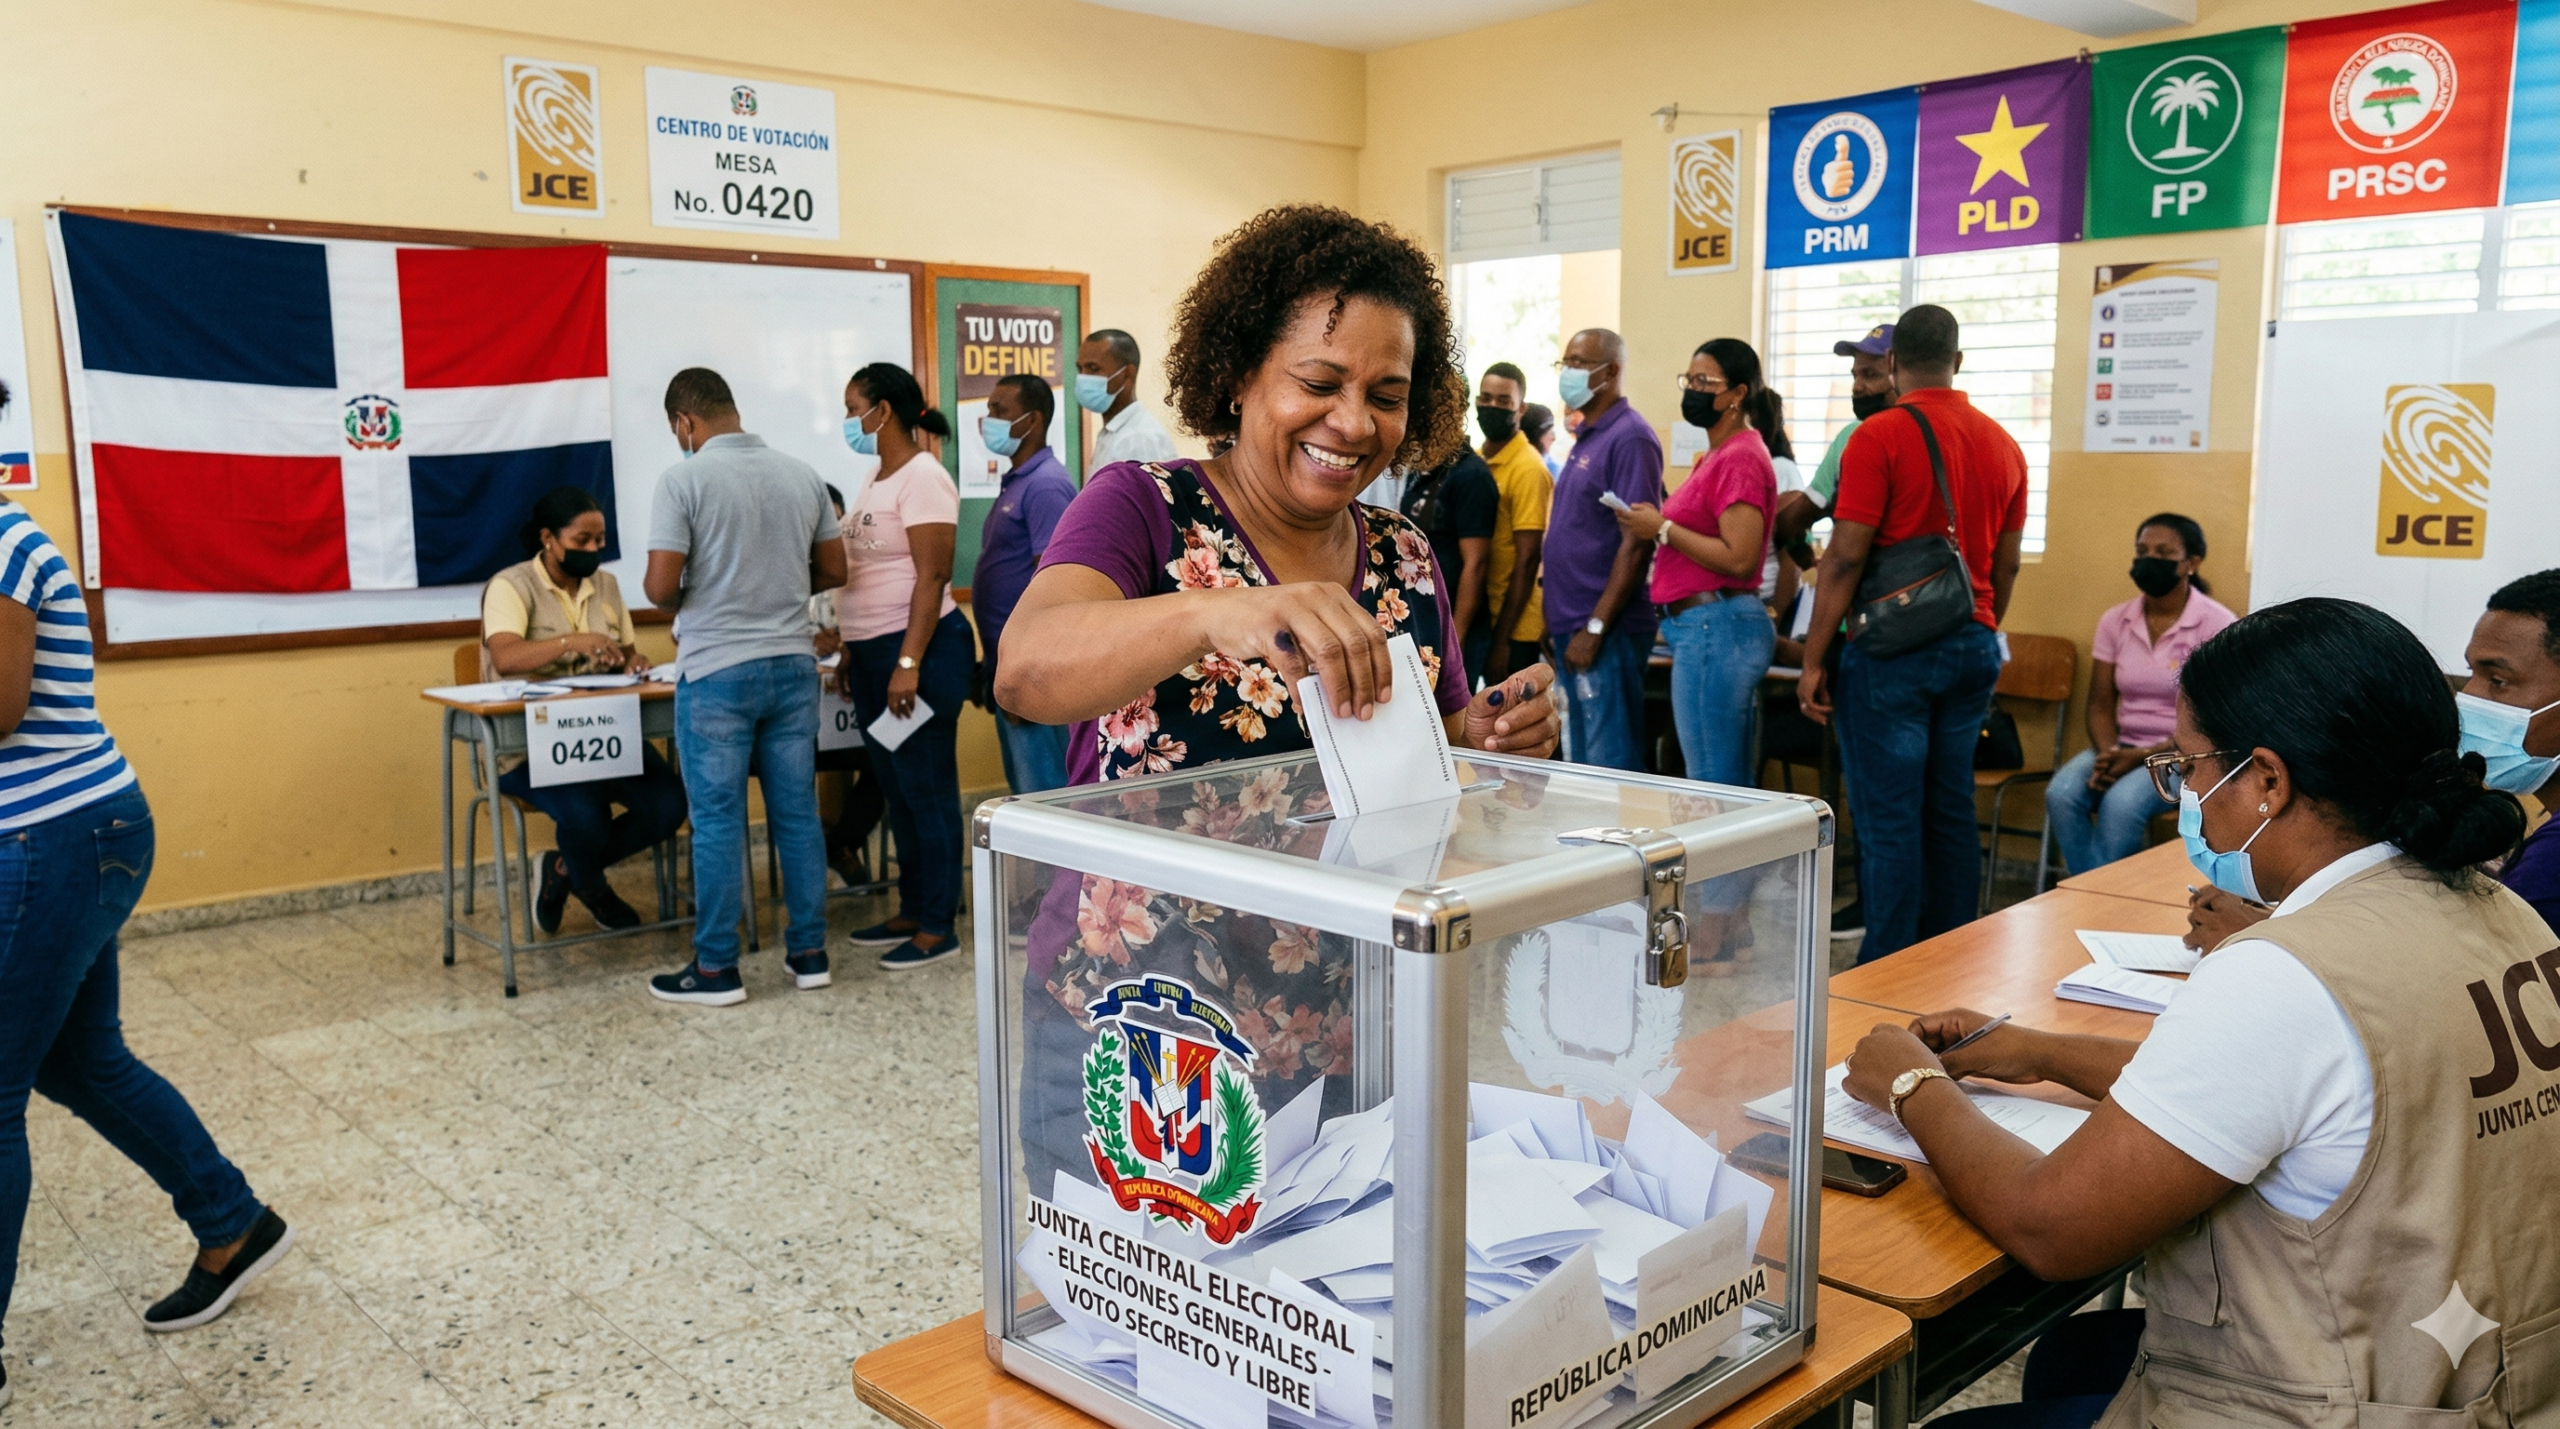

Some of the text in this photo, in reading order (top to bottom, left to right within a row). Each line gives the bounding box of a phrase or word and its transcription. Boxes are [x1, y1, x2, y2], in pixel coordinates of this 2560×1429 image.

[656, 116, 829, 151] CENTRO DE VOTACIÓN
[715, 152, 777, 175] MESA
[2328, 158, 2447, 200] PRSC
[527, 172, 589, 201] JCE
[674, 182, 814, 222] No. 0420
[2151, 181, 2208, 218] FP
[1958, 196, 2040, 236] PLD
[1678, 234, 1727, 261] JCE
[1804, 223, 1869, 255] PRM
[965, 316, 1054, 345] TU VOTO
[964, 345, 1057, 377] DEFINE
[2386, 515, 2474, 546] JCE
[557, 716, 594, 729] MESA
[552, 736, 622, 765] 0420
[2477, 1097, 2537, 1139] JUNTA
[1028, 1200, 1355, 1354] JUNTA CENTRAL ELECTORAL
[1058, 1246, 1180, 1317] ELECCIONES
[1185, 1305, 1318, 1375] GENERALES
[1065, 1279, 1311, 1410] VOTO SECRETO Y LIBRE
[1510, 1341, 1632, 1428] REPÚBLICA
[1637, 1269, 1767, 1359] DOMINICANA
